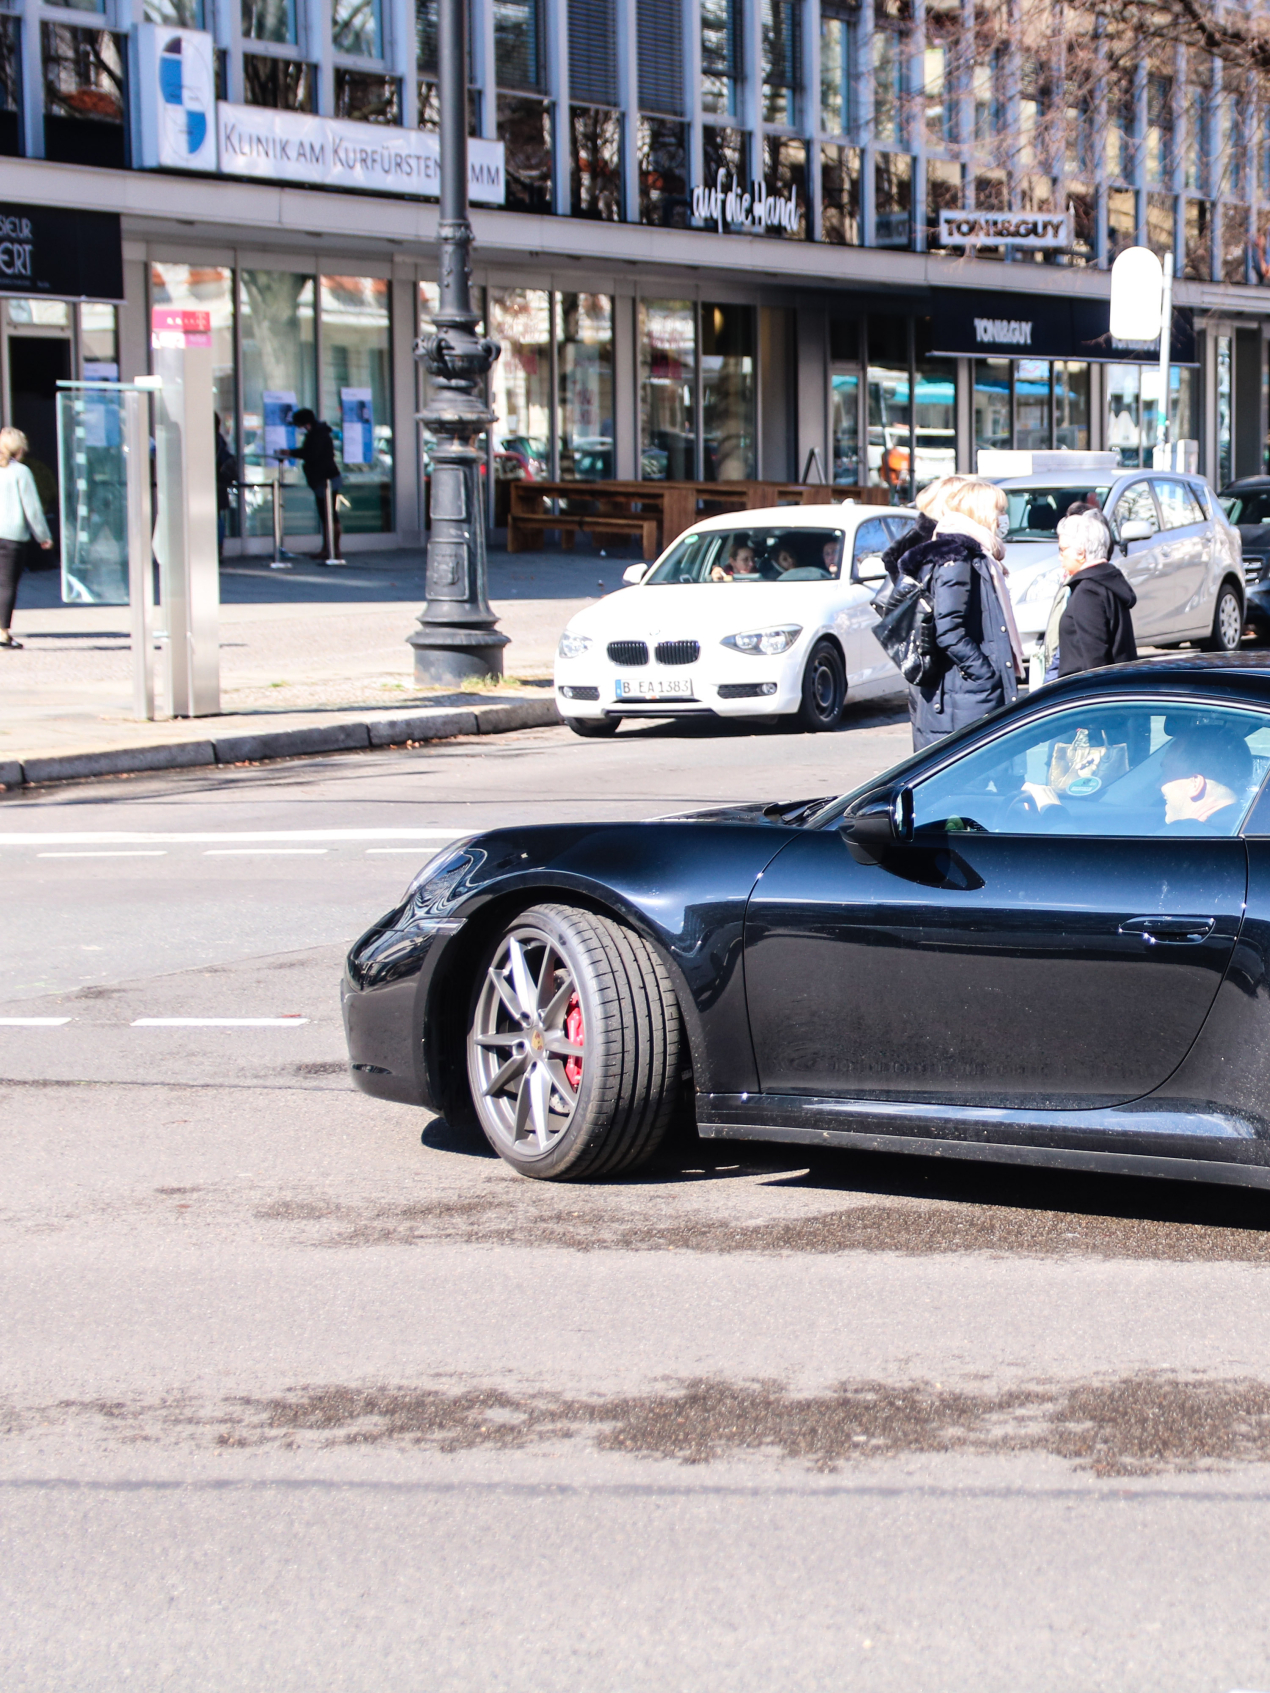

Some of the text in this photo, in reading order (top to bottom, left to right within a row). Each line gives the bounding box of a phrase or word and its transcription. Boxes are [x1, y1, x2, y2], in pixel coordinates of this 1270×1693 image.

[223, 121, 500, 187] KLINIK AM KURFÜRSTENMM
[692, 166, 800, 235] auf die Hand
[973, 317, 1032, 345] TONI&GUY
[622, 679, 689, 694] B EA 1383
